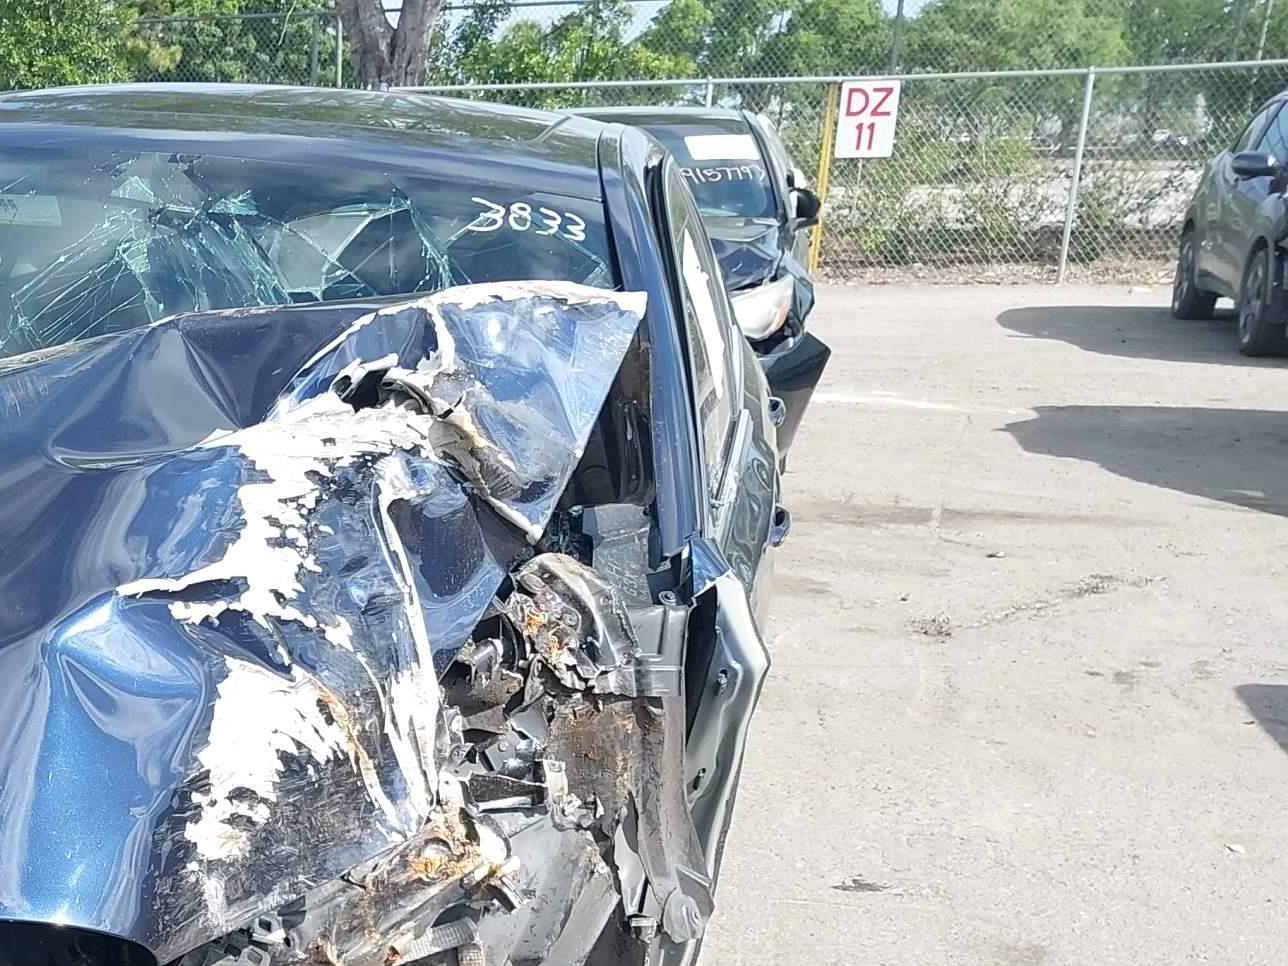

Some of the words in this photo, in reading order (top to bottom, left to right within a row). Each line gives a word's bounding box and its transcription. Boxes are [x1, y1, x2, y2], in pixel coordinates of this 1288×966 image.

[845, 87, 894, 117] DZ
[855, 122, 876, 151] 11
[467, 197, 587, 242] 3833
